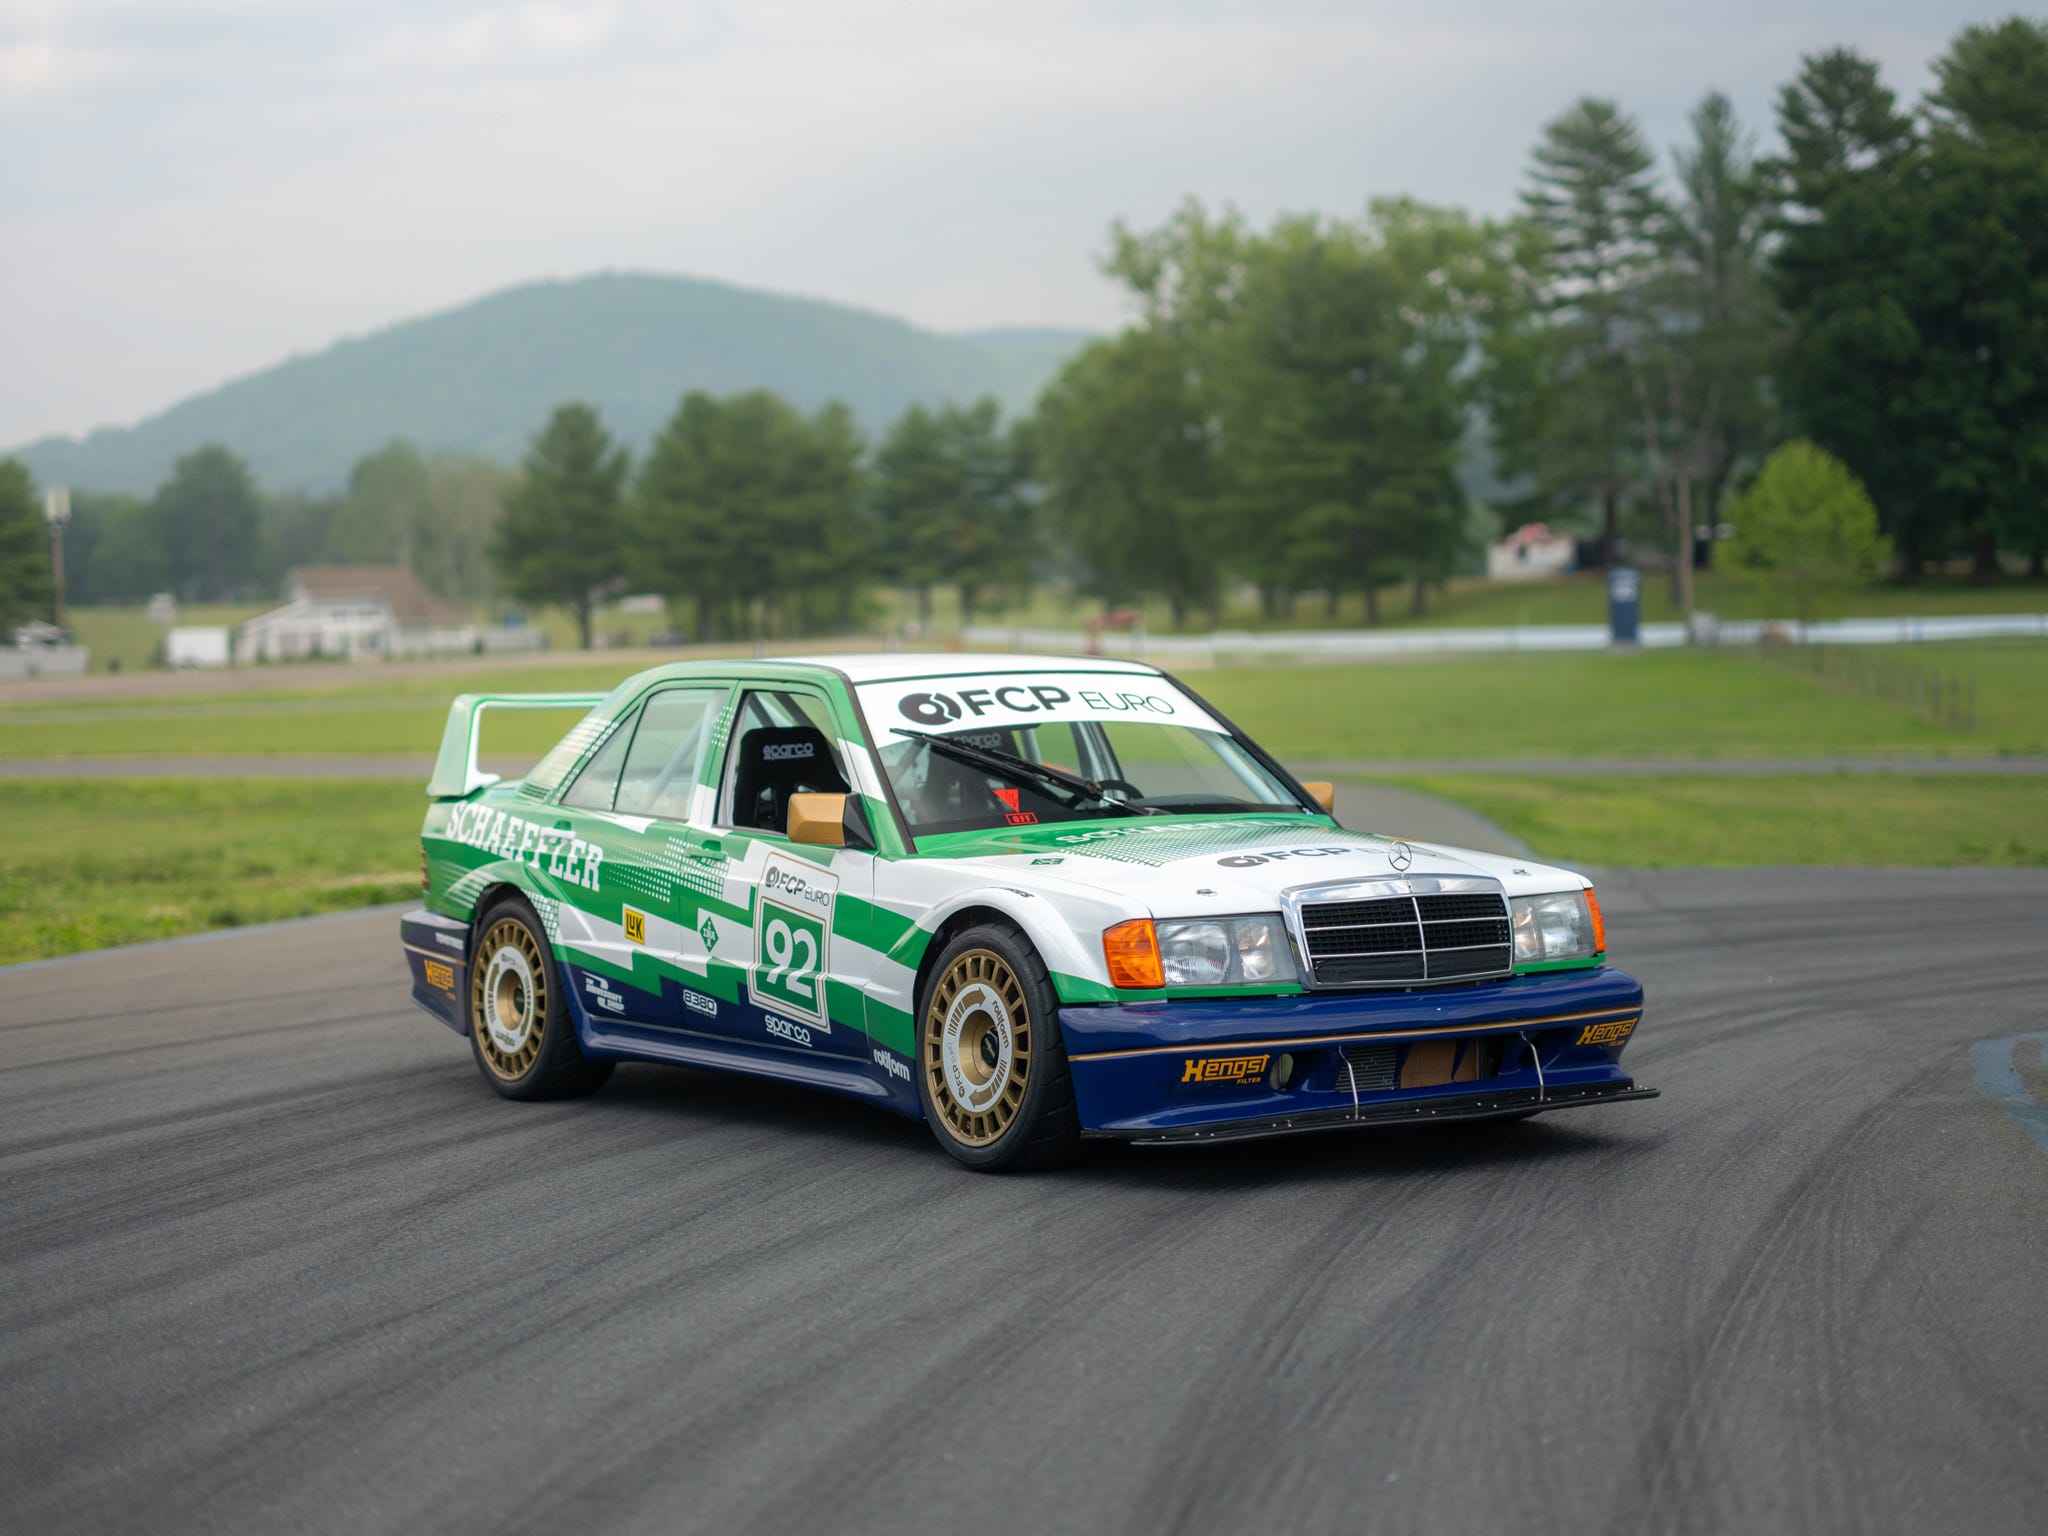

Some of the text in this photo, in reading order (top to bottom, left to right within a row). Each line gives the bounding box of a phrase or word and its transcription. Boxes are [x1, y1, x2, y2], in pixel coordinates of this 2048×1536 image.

[956, 686, 1175, 716] FCP EURO
[763, 743, 814, 761] sparco
[446, 800, 604, 892] SCHAEFFLER
[1261, 848, 1351, 860] FCP
[777, 872, 830, 907] FCP EURO
[765, 918, 817, 999] 92
[765, 1014, 811, 1043] sparco
[992, 1000, 1010, 1049] rotiform
[1575, 1017, 1639, 1046] Hengst
[873, 1048, 910, 1082] rotiform
[1181, 1053, 1271, 1083] Hengst
[1236, 1077, 1262, 1085] FILTER
